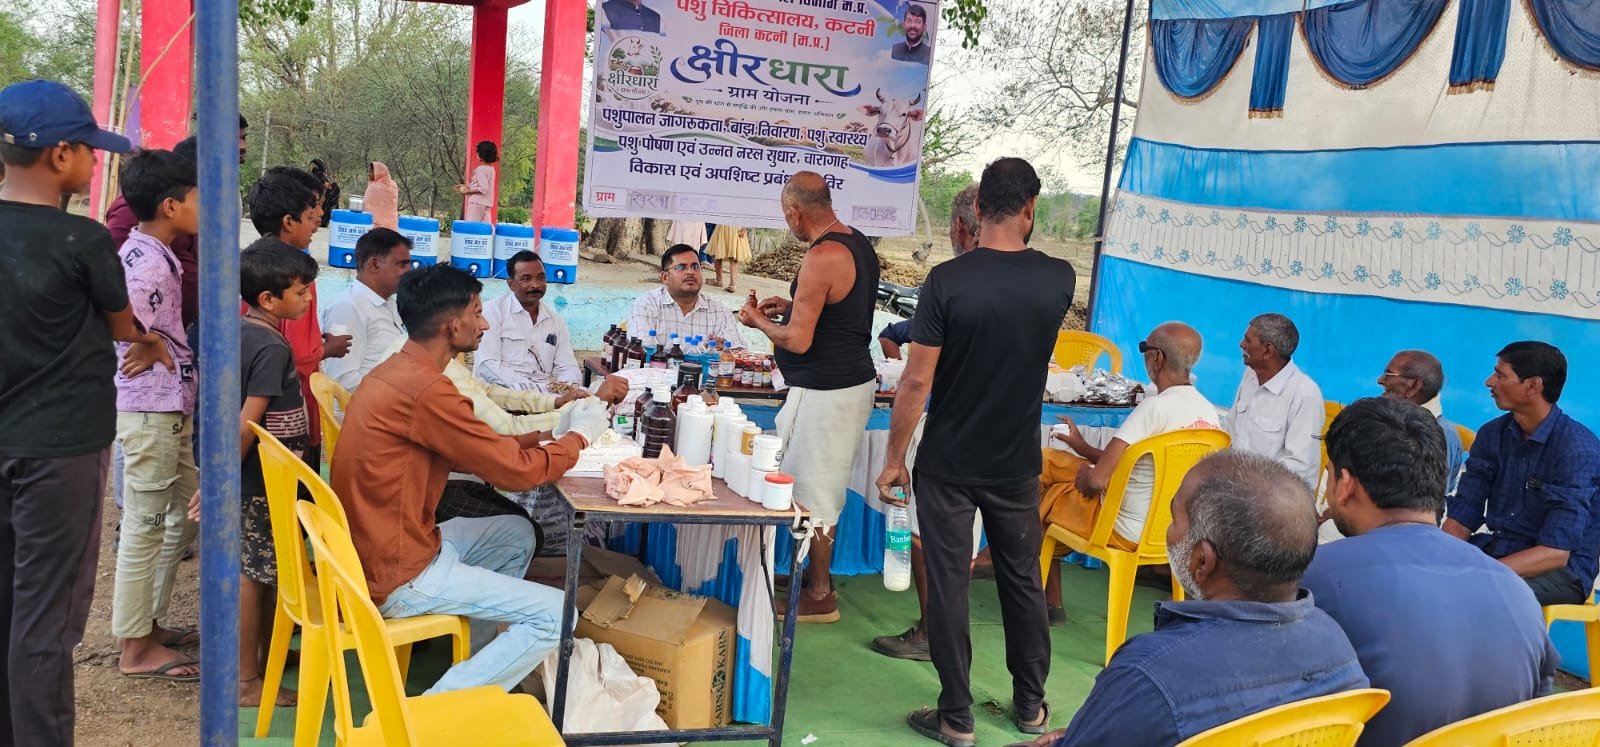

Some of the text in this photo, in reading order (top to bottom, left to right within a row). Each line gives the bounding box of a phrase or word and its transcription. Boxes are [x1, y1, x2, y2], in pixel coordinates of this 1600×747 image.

[677, 0, 876, 37] पशु चिकित्सालय, कटनी
[719, 23, 749, 38] जिला
[755, 28, 787, 44] कटनी
[674, 39, 858, 93] क्षीरधारा
[608, 69, 660, 91] क्षीरधारा
[728, 86, 811, 106] ग्राम योजना
[602, 107, 656, 128] पशुपालन
[730, 118, 756, 137] बांझ
[806, 129, 826, 147] पशु
[618, 135, 638, 155] पशु
[643, 134, 674, 153] पोषण
[677, 138, 696, 157] एवं
[699, 143, 734, 158] उन्नत
[804, 152, 849, 170] चारागाह
[629, 157, 676, 176] विकास
[680, 162, 702, 180] एवं
[705, 166, 761, 183] अपशिष्ट
[595, 191, 616, 203] ग्राम
